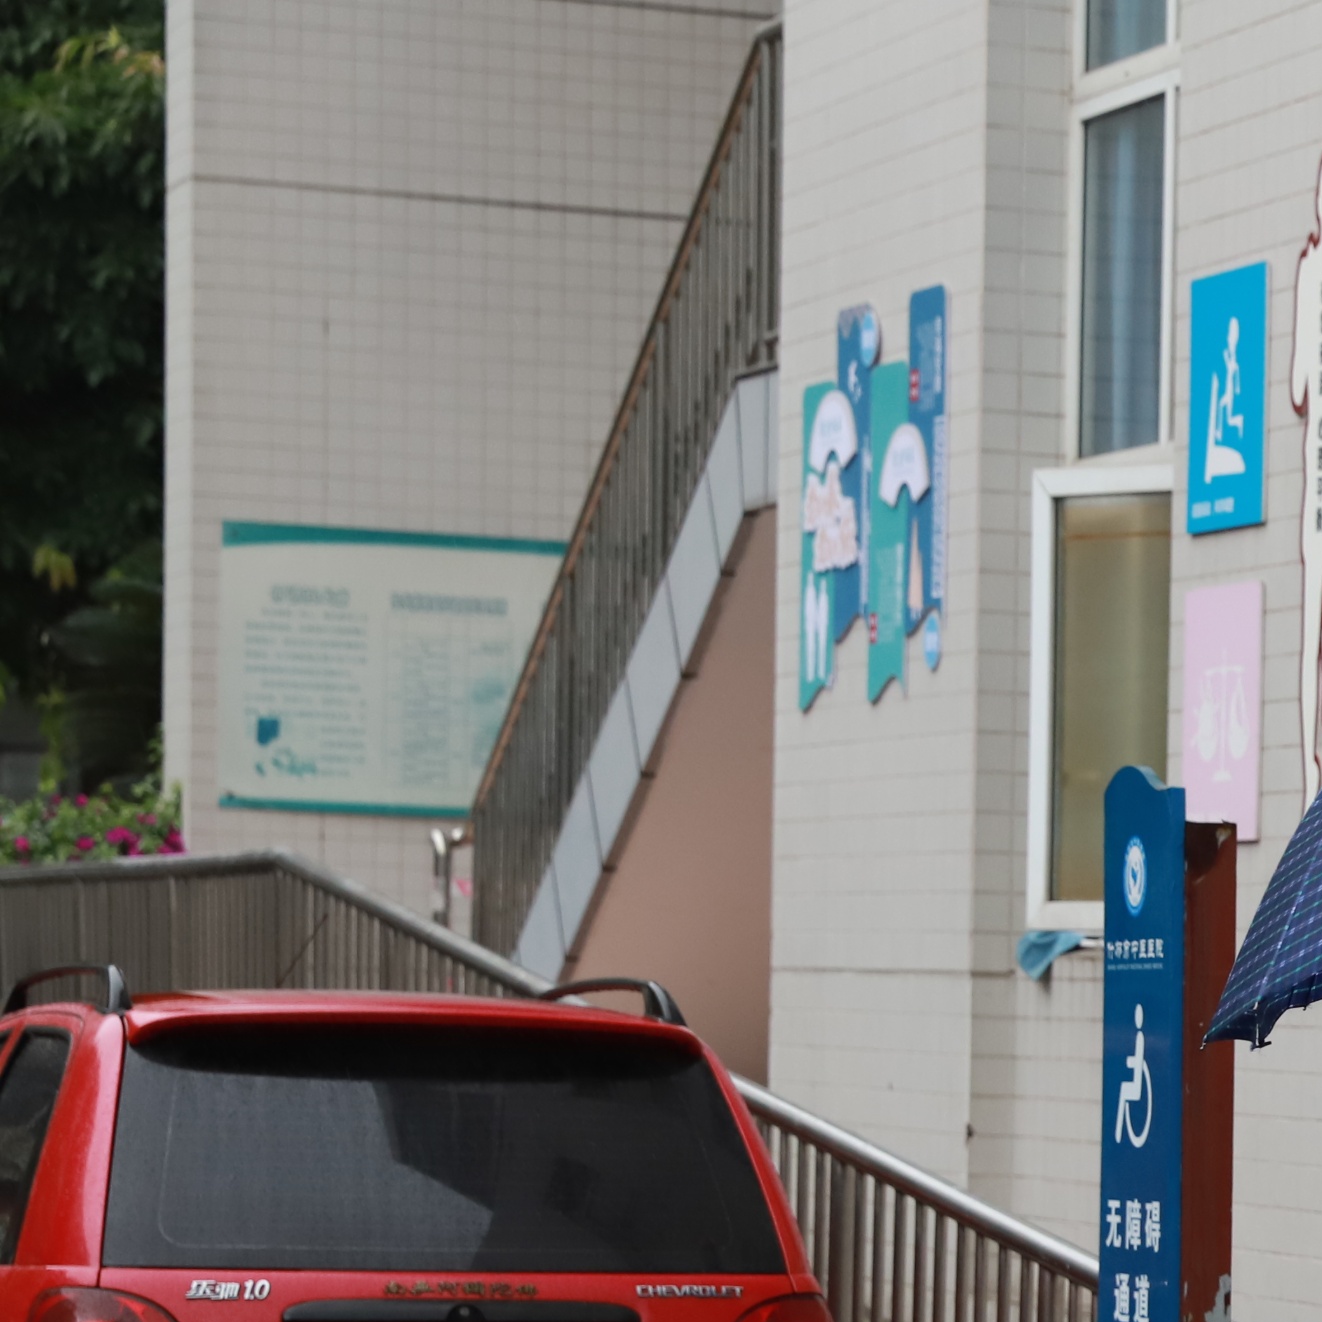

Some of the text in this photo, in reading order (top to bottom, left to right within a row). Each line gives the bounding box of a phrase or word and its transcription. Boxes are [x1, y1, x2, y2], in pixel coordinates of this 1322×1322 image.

[1105, 1199, 1162, 1253] 无障碍
[635, 1284, 744, 1298] CHEVROLET
